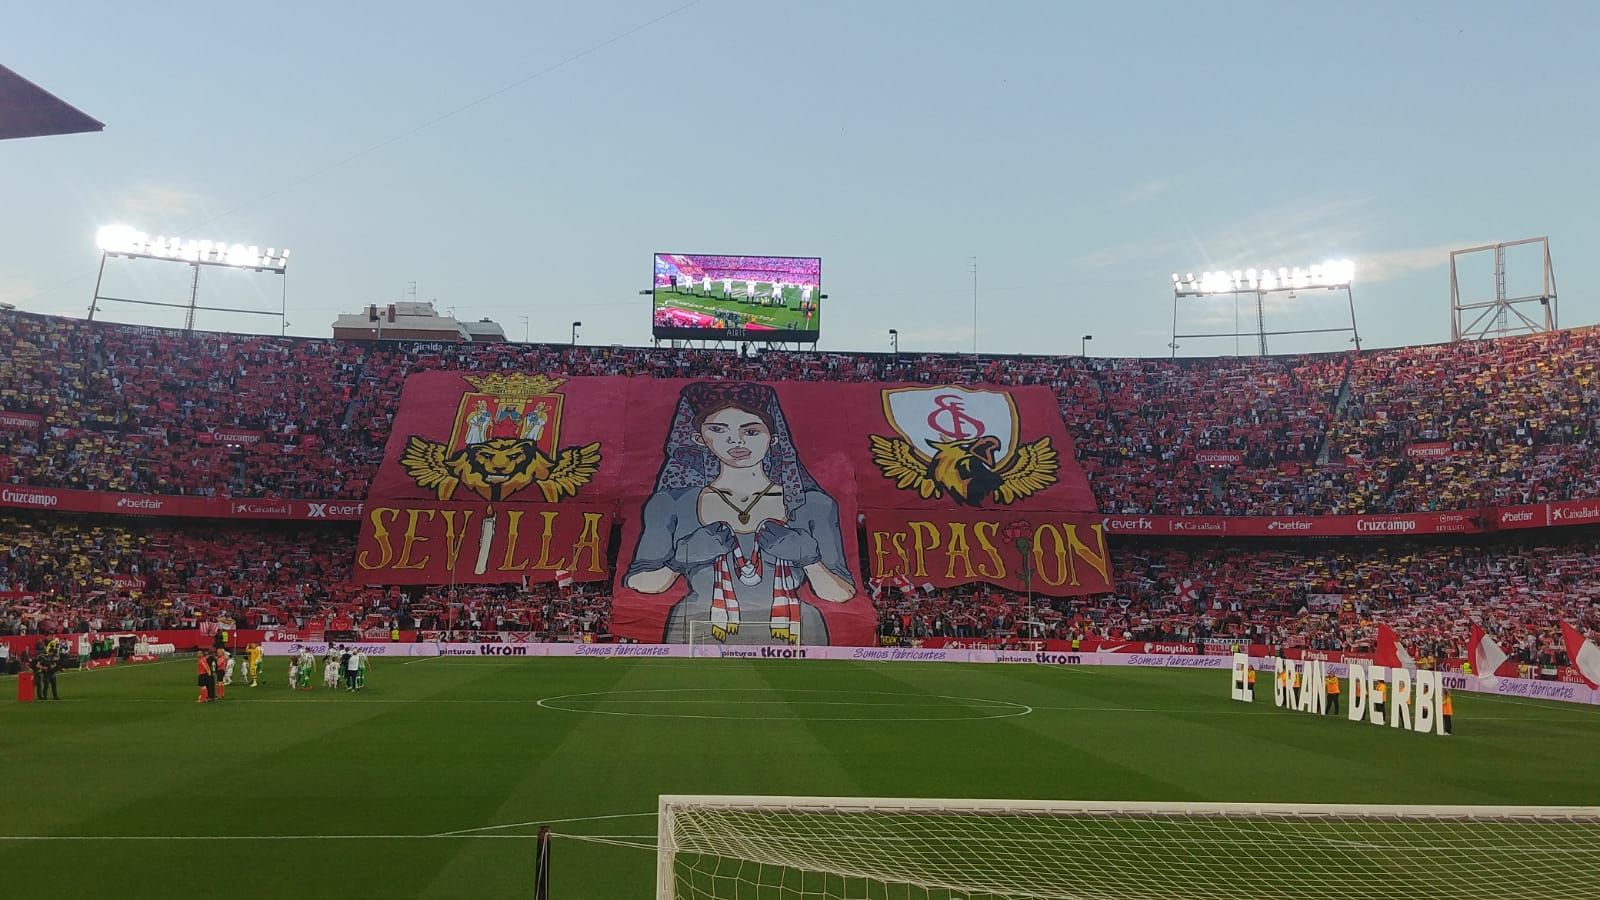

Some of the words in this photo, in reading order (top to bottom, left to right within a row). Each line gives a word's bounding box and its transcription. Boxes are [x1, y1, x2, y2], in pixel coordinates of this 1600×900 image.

[1196, 453, 1240, 463] Cruzcampo
[2, 489, 58, 506] Cruzcampo
[127, 498, 163, 509] betfair
[328, 503, 363, 515] everf
[1563, 506, 1600, 519] CaixaBank
[1508, 511, 1533, 521] betfair
[1111, 518, 1152, 530] everfx
[1184, 521, 1222, 531] CaixaBank
[1278, 520, 1313, 531] betfair
[1356, 519, 1416, 531] Cruzcampo
[440, 648, 476, 656] pinturas
[480, 644, 527, 656] tkrom
[575, 645, 611, 655] Somos
[613, 645, 670, 656] fabricantes
[721, 650, 757, 658] pinturas
[761, 646, 806, 658] tkrom
[853, 648, 889, 659] Somos
[890, 649, 946, 660] fabricantes
[1155, 644, 1194, 655] Playtika
[997, 655, 1032, 663] pinturas
[1035, 652, 1081, 664] tkrom
[1127, 655, 1164, 665] Somos
[1165, 655, 1222, 667] fabricantes
[1232, 653, 1252, 702] EL
[1274, 656, 1325, 715] GRAN
[1348, 663, 1445, 735] DERBI
[1499, 679, 1527, 692] Somos
[1528, 680, 1574, 699] fabricantes
